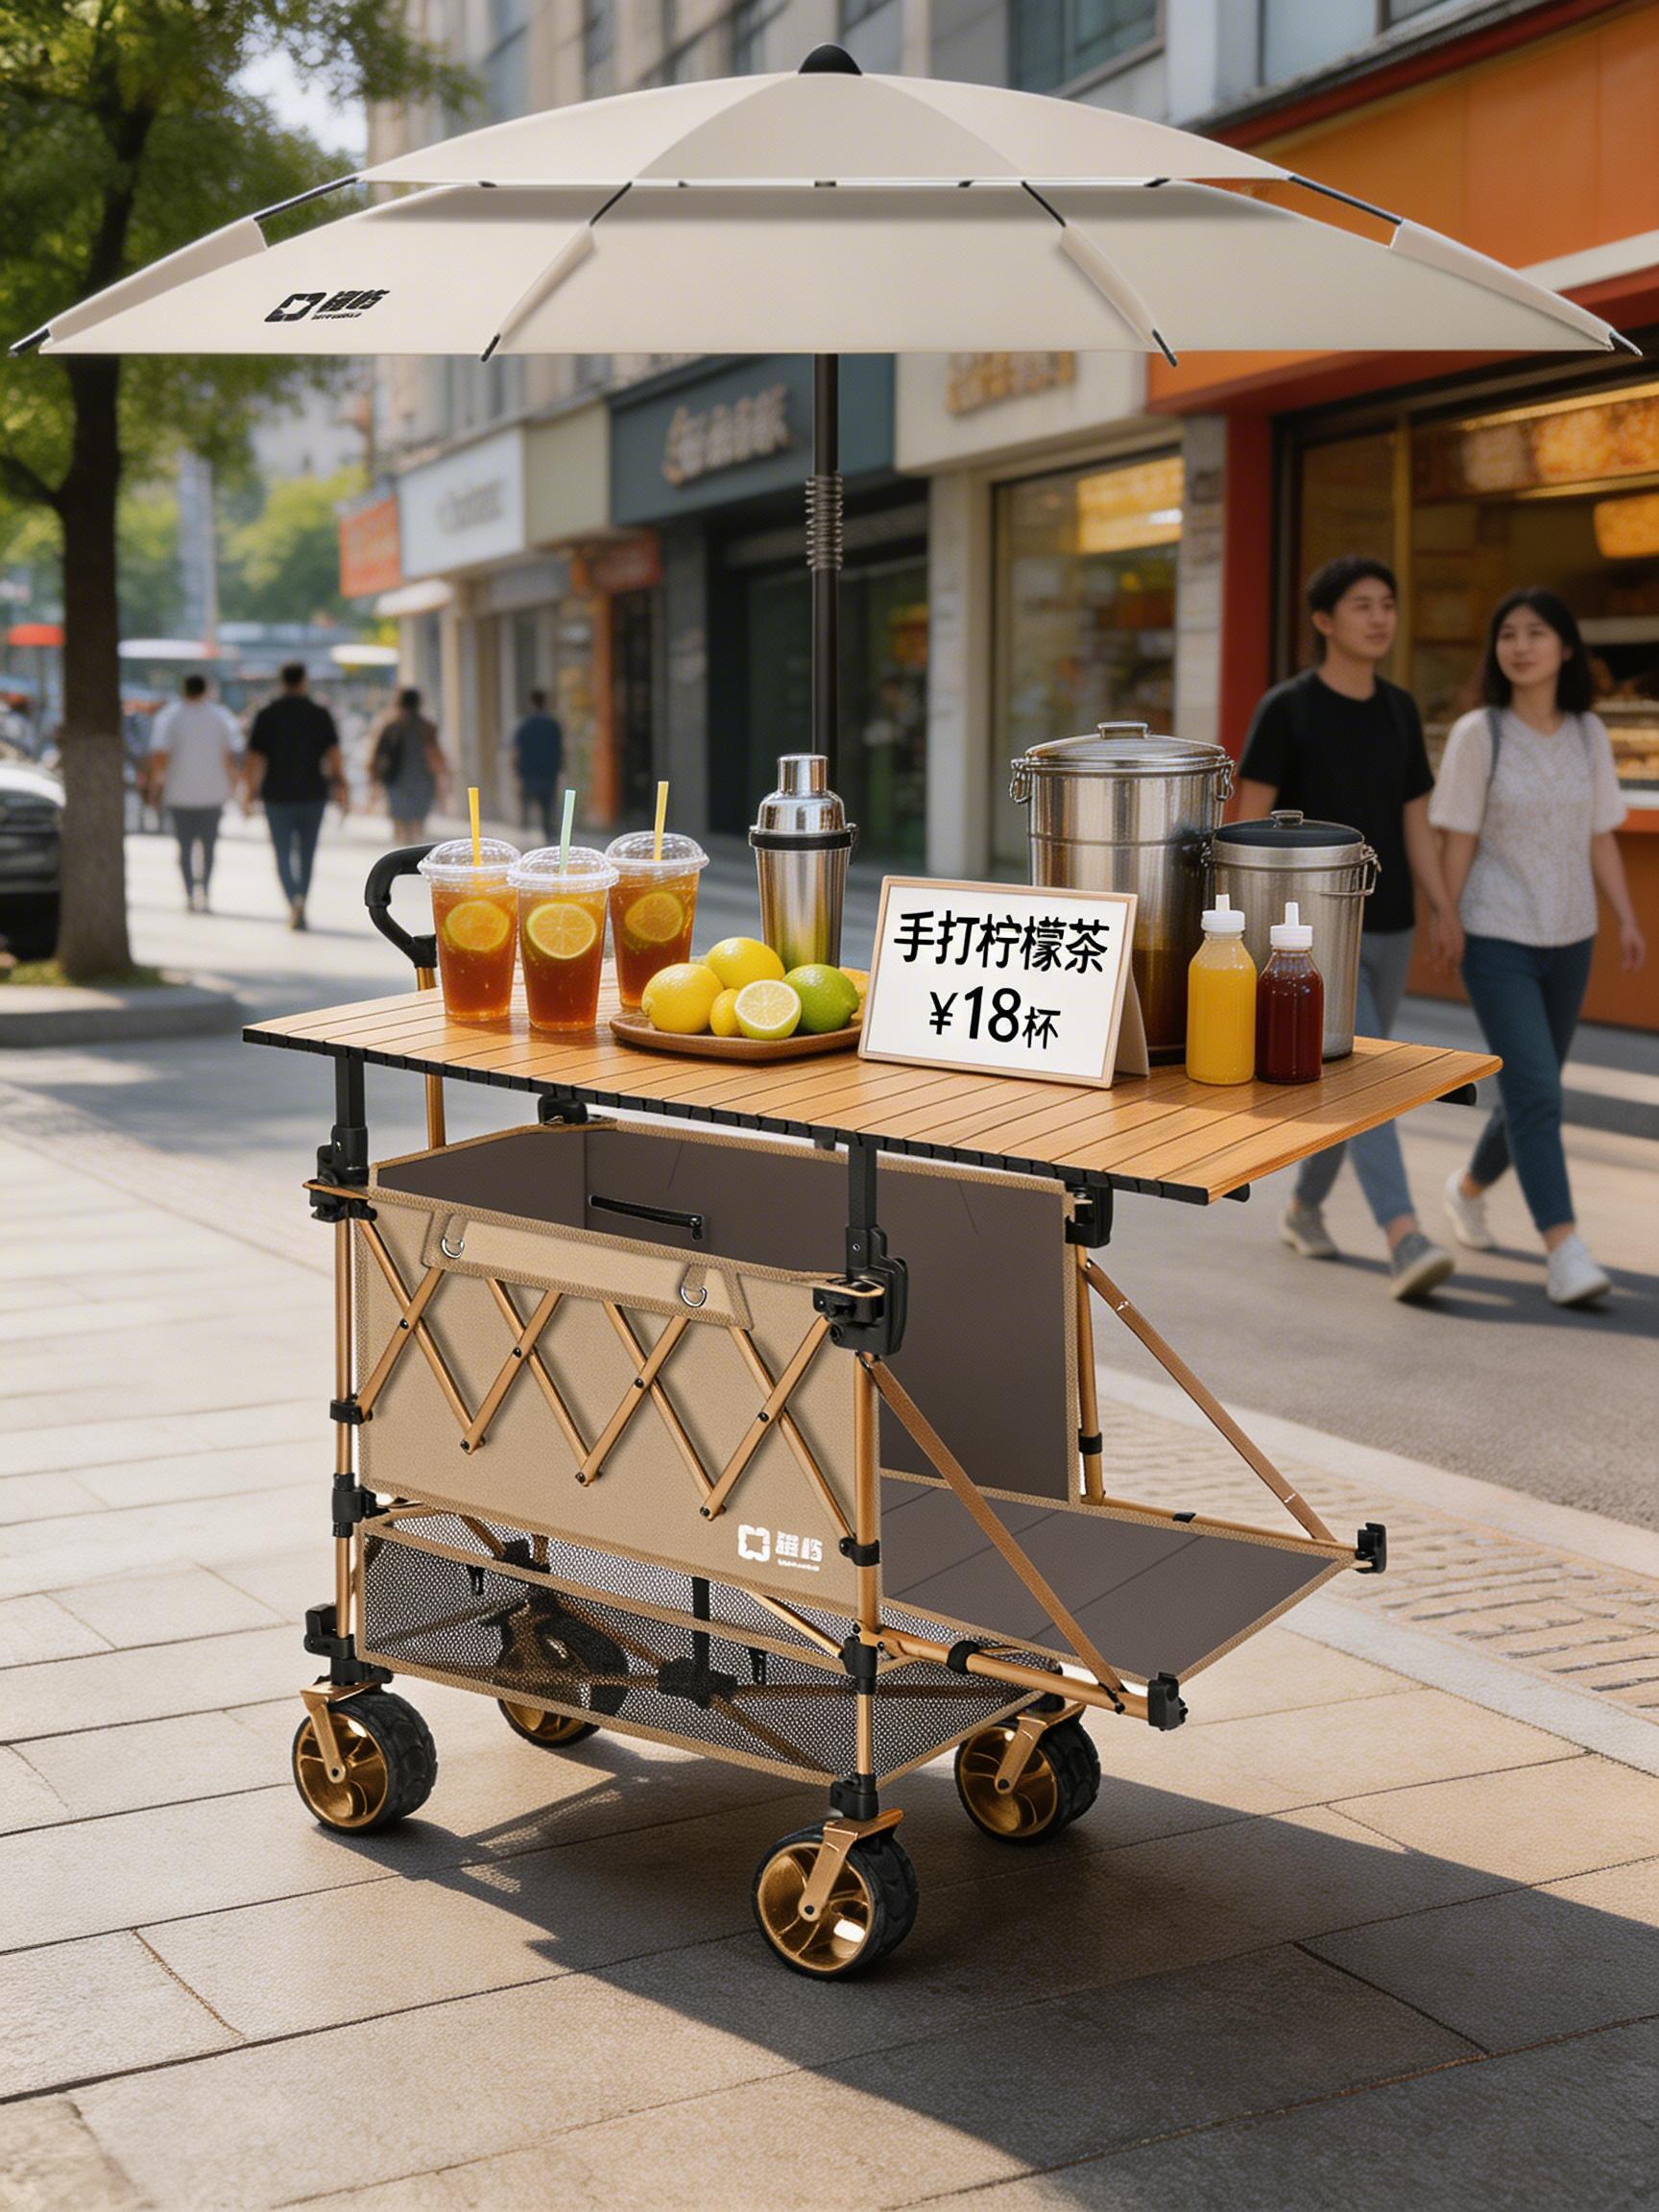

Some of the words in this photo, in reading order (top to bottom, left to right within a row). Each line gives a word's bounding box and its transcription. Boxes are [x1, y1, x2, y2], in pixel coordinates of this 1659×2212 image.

[894, 910, 1109, 974] 手打柠檬茶
